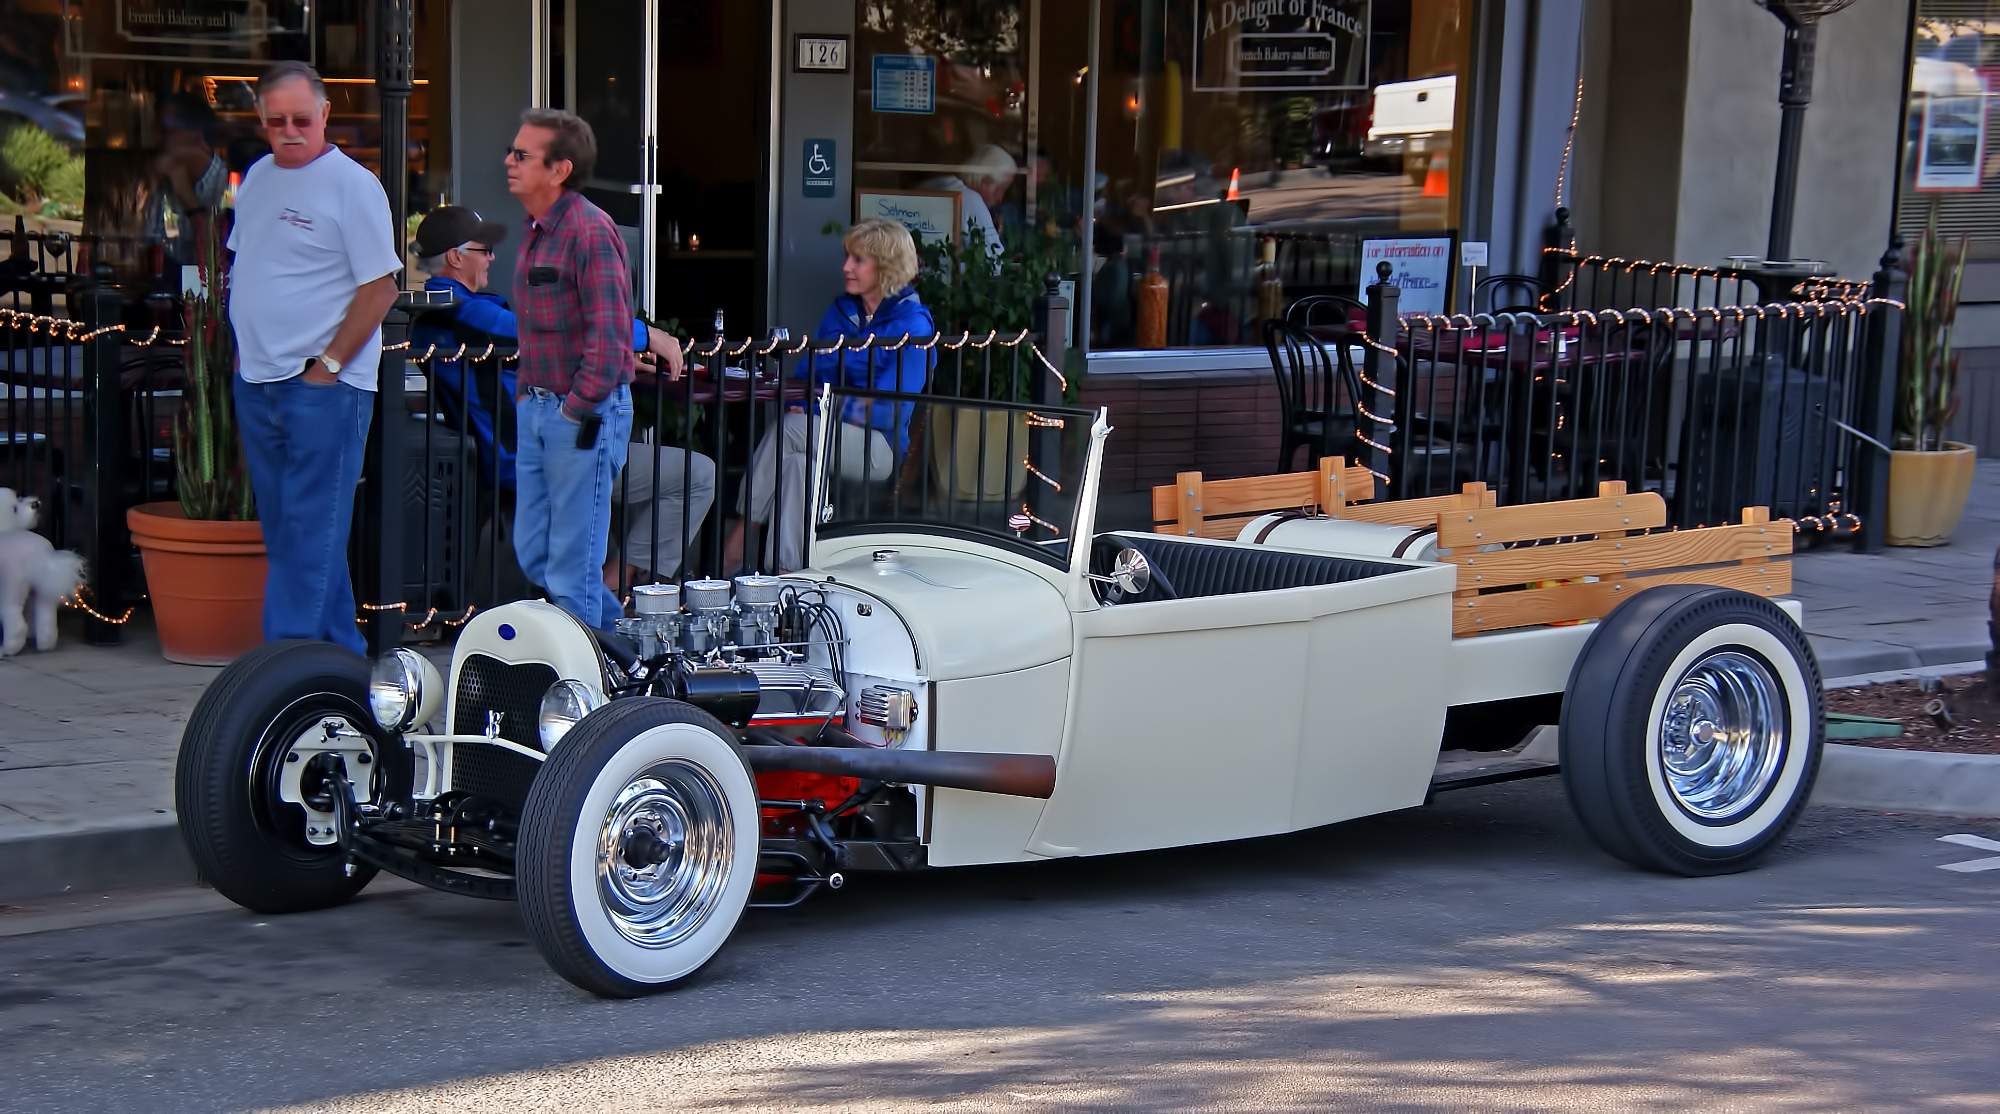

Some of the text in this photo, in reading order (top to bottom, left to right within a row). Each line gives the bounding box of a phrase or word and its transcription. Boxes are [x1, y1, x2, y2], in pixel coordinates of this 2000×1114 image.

[128, 8, 164, 24] French
[207, 11, 226, 27] and
[1203, 0, 1363, 41] A Delight of France
[810, 44, 838, 64] 126
